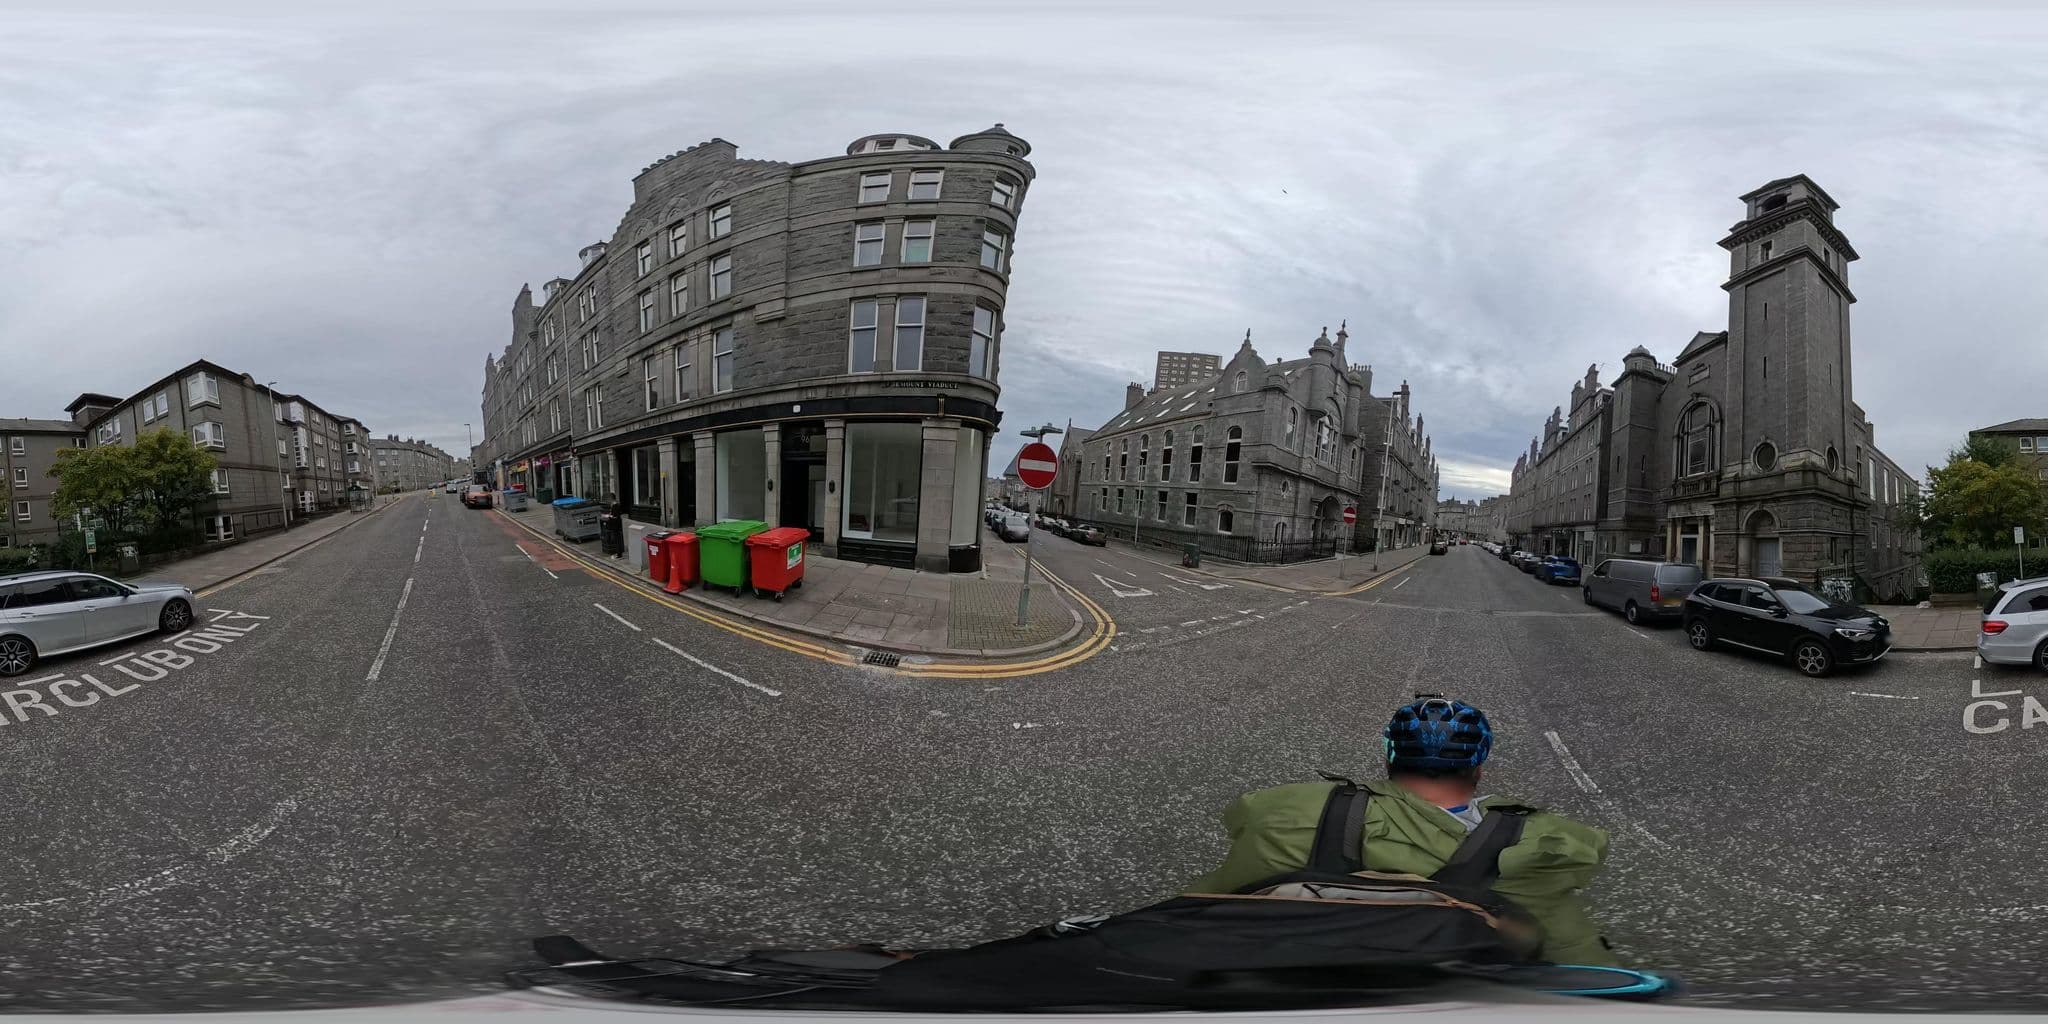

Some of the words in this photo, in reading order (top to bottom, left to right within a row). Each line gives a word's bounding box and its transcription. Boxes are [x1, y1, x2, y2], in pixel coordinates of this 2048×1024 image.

[880, 381, 924, 389] EMOUNT
[0, 689, 59, 725] R
[49, 650, 195, 707] CLUB
[173, 608, 271, 654] ONLY
